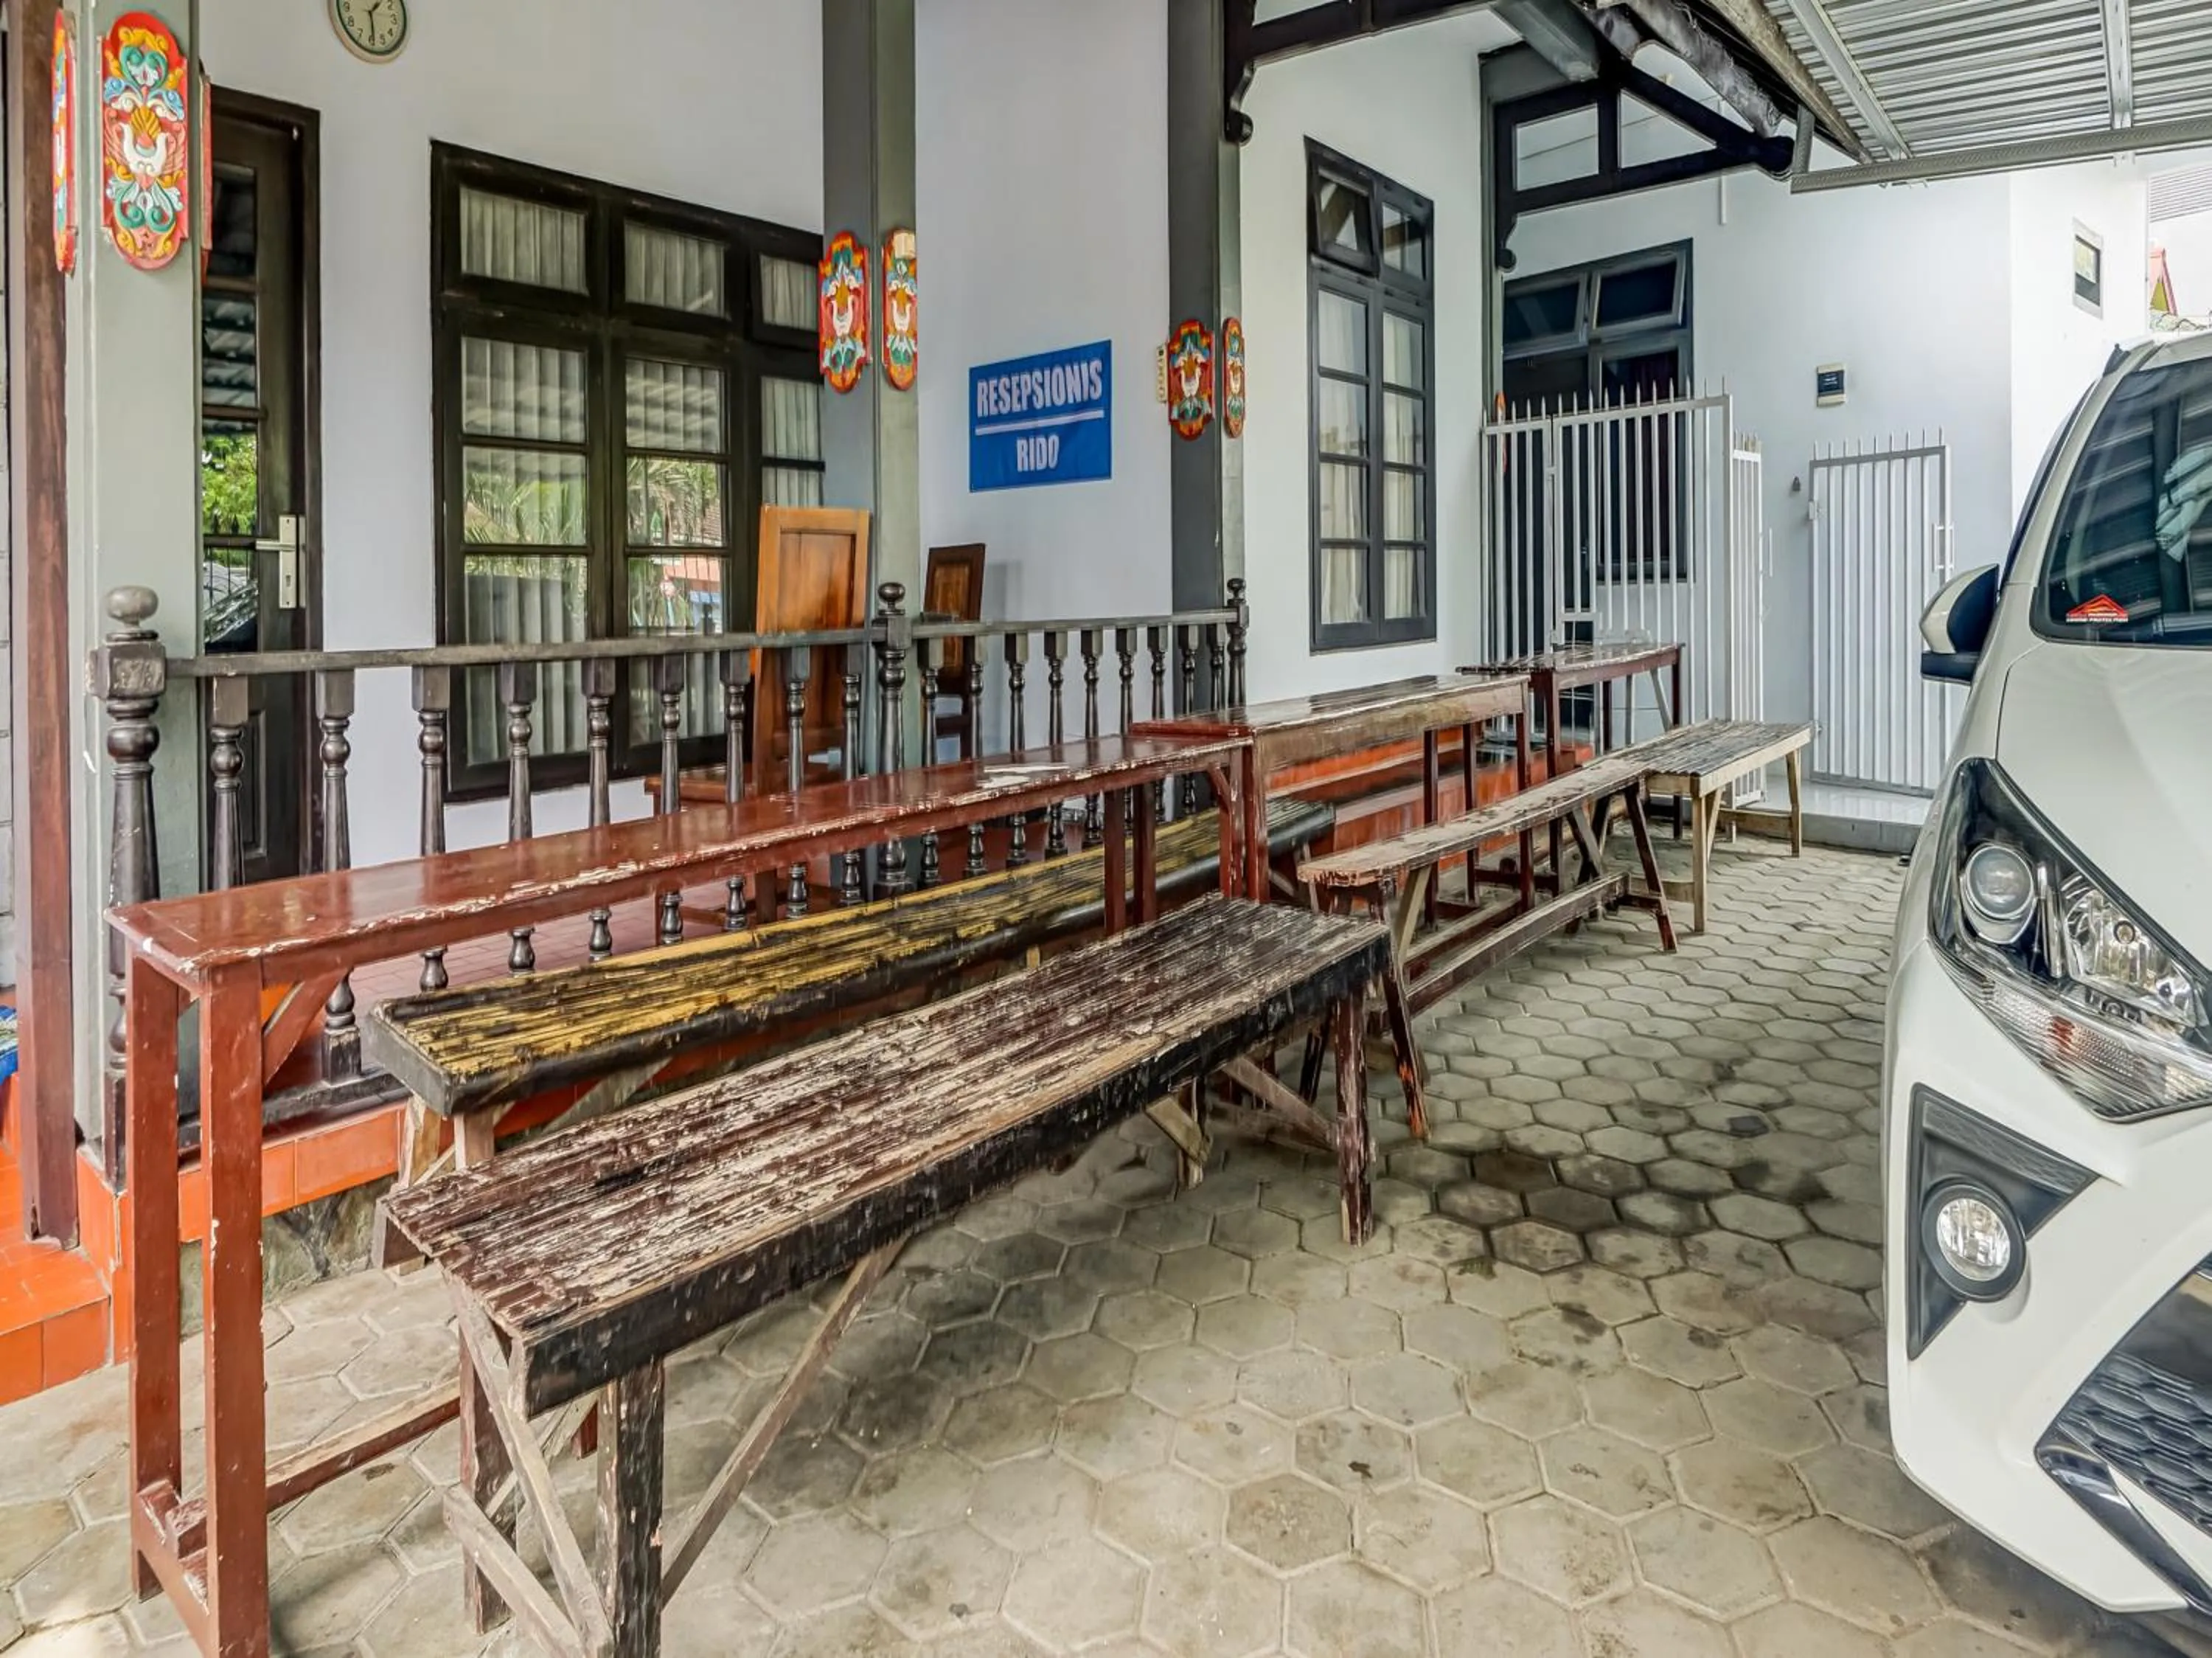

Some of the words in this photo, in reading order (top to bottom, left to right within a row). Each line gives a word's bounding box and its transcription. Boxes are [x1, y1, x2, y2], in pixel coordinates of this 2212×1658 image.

[344, 1, 350, 12] 9
[387, 0, 393, 10] 2
[347, 15, 354, 27] 8
[390, 13, 397, 25] 3
[357, 28, 364, 38] 7
[387, 28, 393, 37] 4
[380, 33, 386, 44] 5
[977, 359, 1102, 417] RESEPSIONIS
[1016, 434, 1060, 472] RIDO
